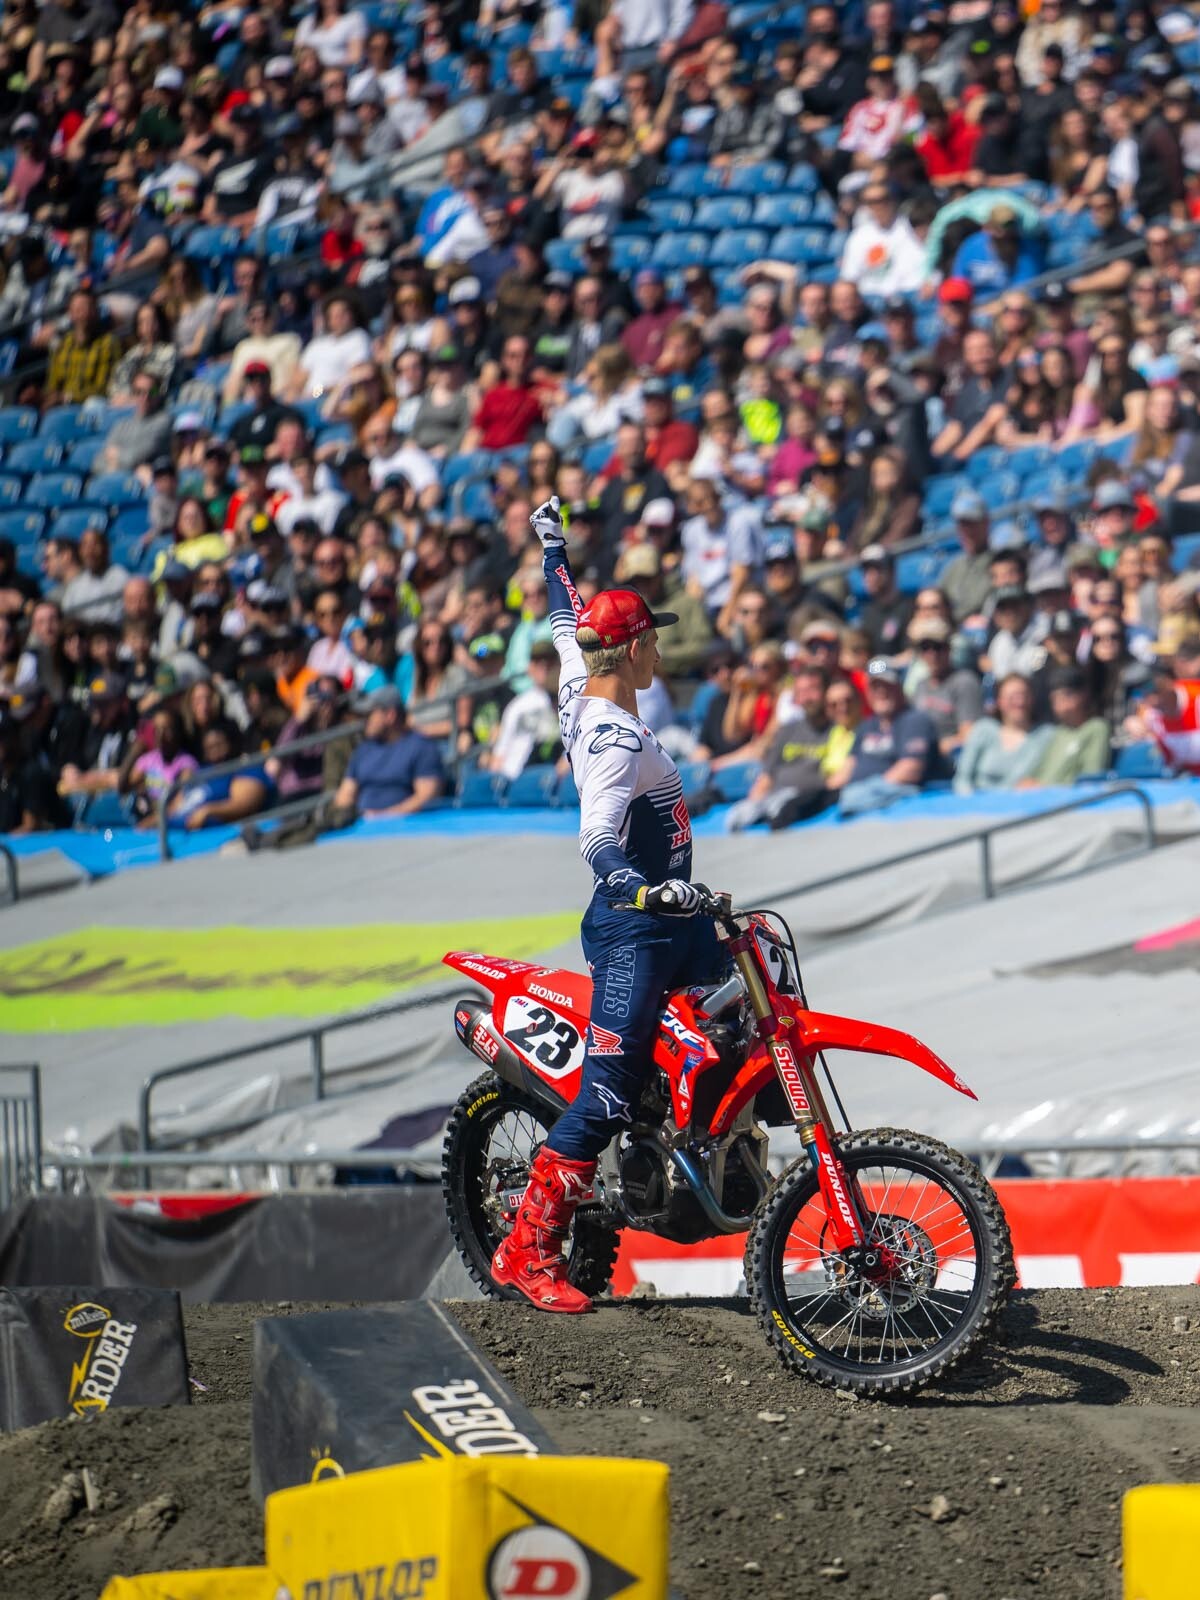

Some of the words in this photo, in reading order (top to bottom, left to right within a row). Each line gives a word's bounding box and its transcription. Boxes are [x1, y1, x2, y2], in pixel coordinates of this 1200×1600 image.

[459, 960, 507, 980] DUNLOP
[602, 943, 636, 1018] STARS
[770, 946, 797, 995] 2
[527, 982, 573, 1008] HONDA
[504, 1007, 579, 1070] 23
[773, 1046, 811, 1111] SHOWA
[466, 1091, 499, 1119] DUNLOP
[821, 1151, 855, 1229] DUNLOP
[771, 1310, 817, 1359] DUNLOP
[412, 1379, 539, 1459] DER
[501, 1559, 581, 1597] D
